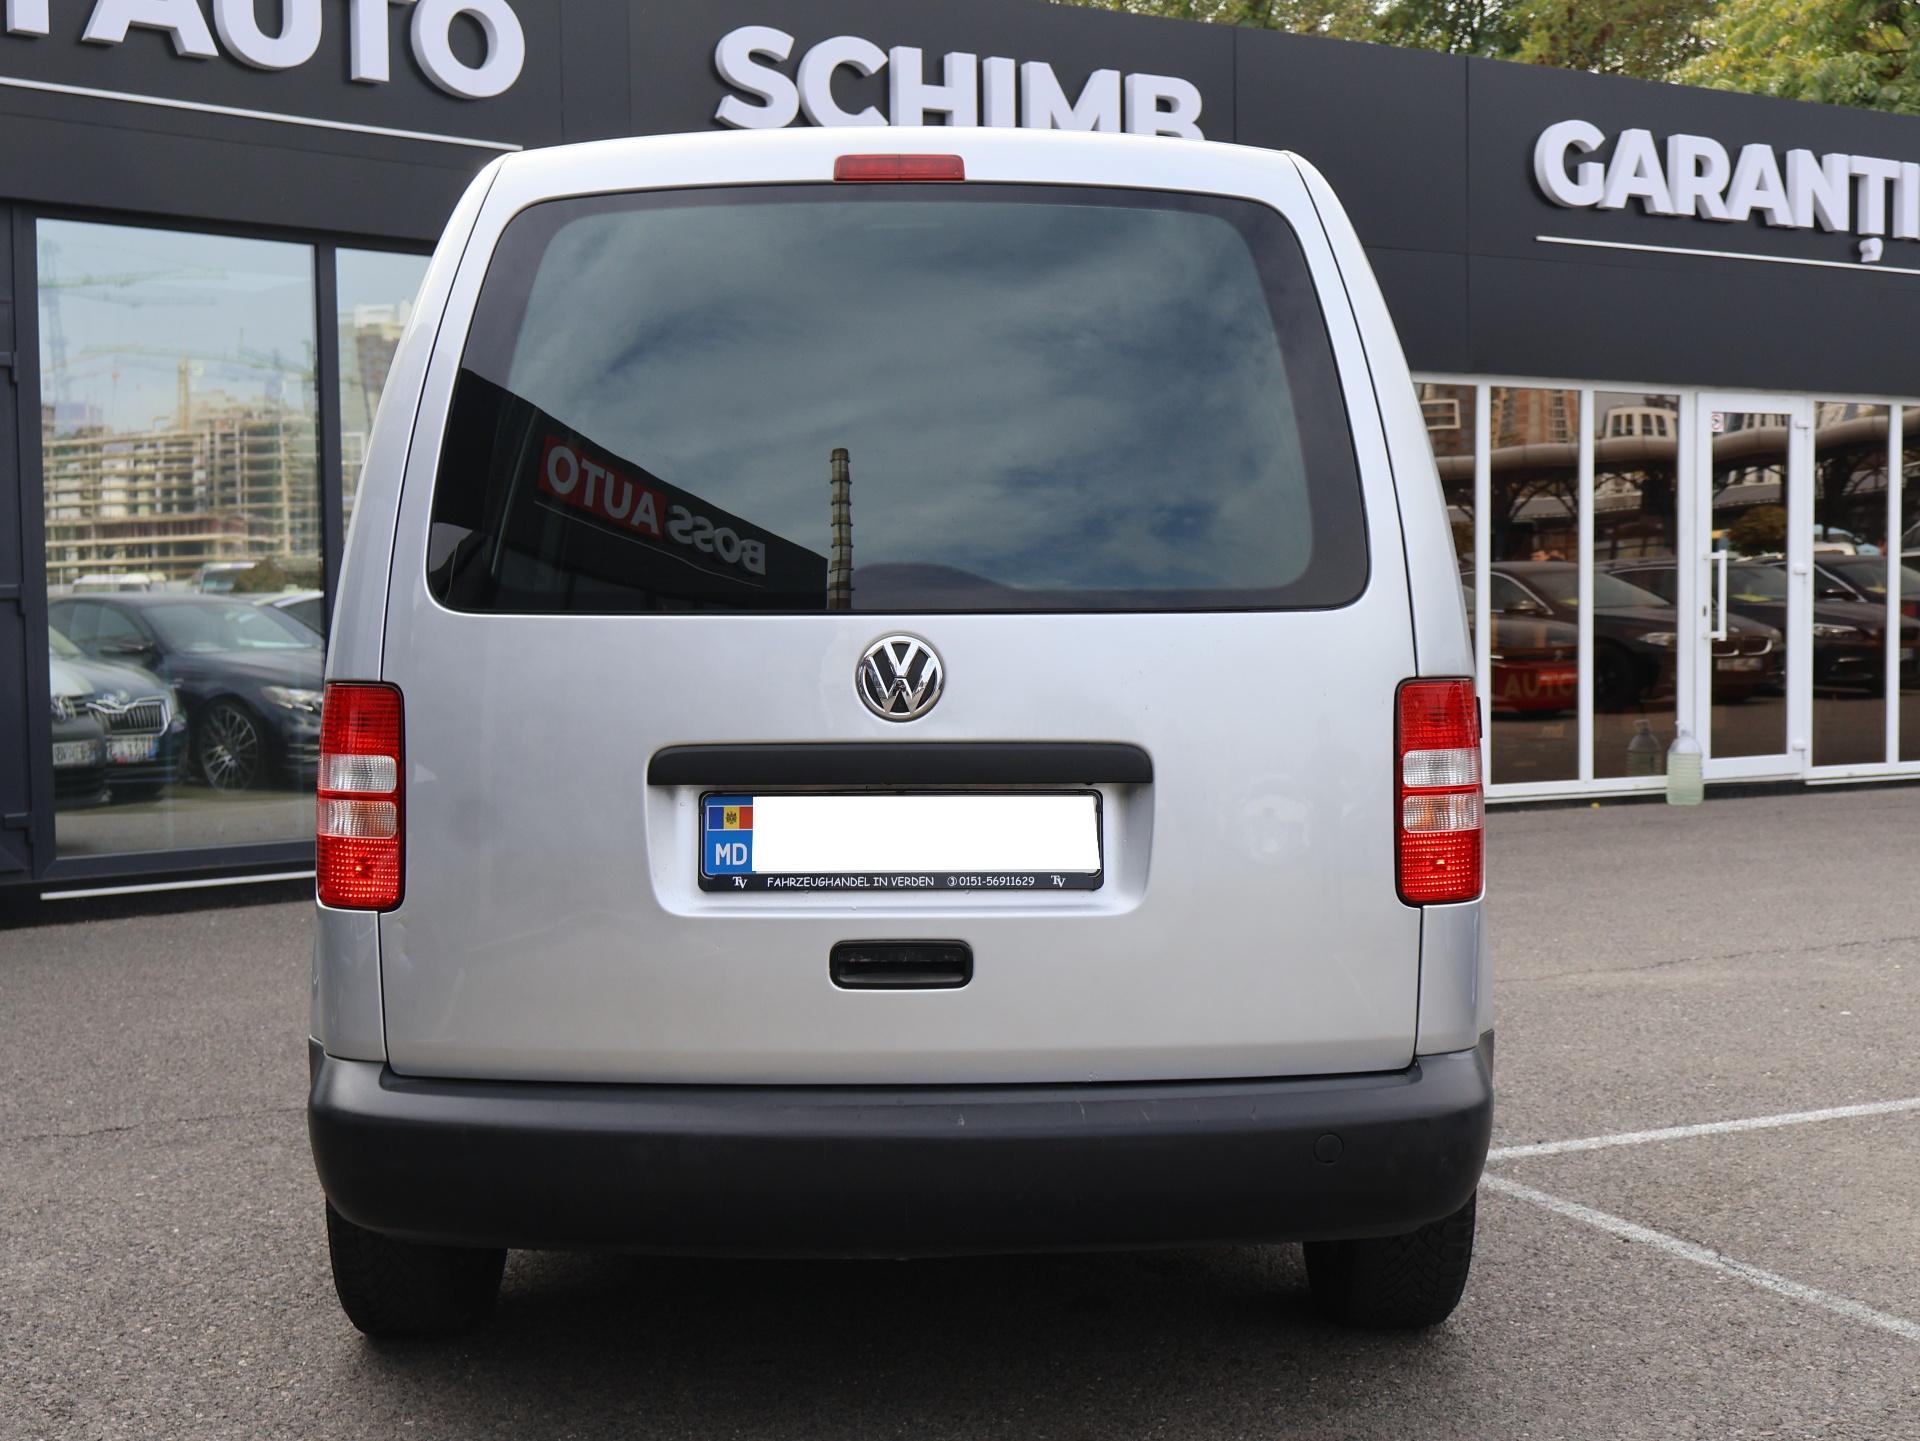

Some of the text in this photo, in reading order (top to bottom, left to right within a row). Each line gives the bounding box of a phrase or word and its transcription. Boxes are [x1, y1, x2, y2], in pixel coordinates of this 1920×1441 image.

[714, 25, 1205, 141] SCHIMB
[714, 842, 748, 866] MD
[767, 876, 934, 888] FAHRZEUGHANDEL IN VERDEN
[958, 876, 1035, 887] 0151-56911629
